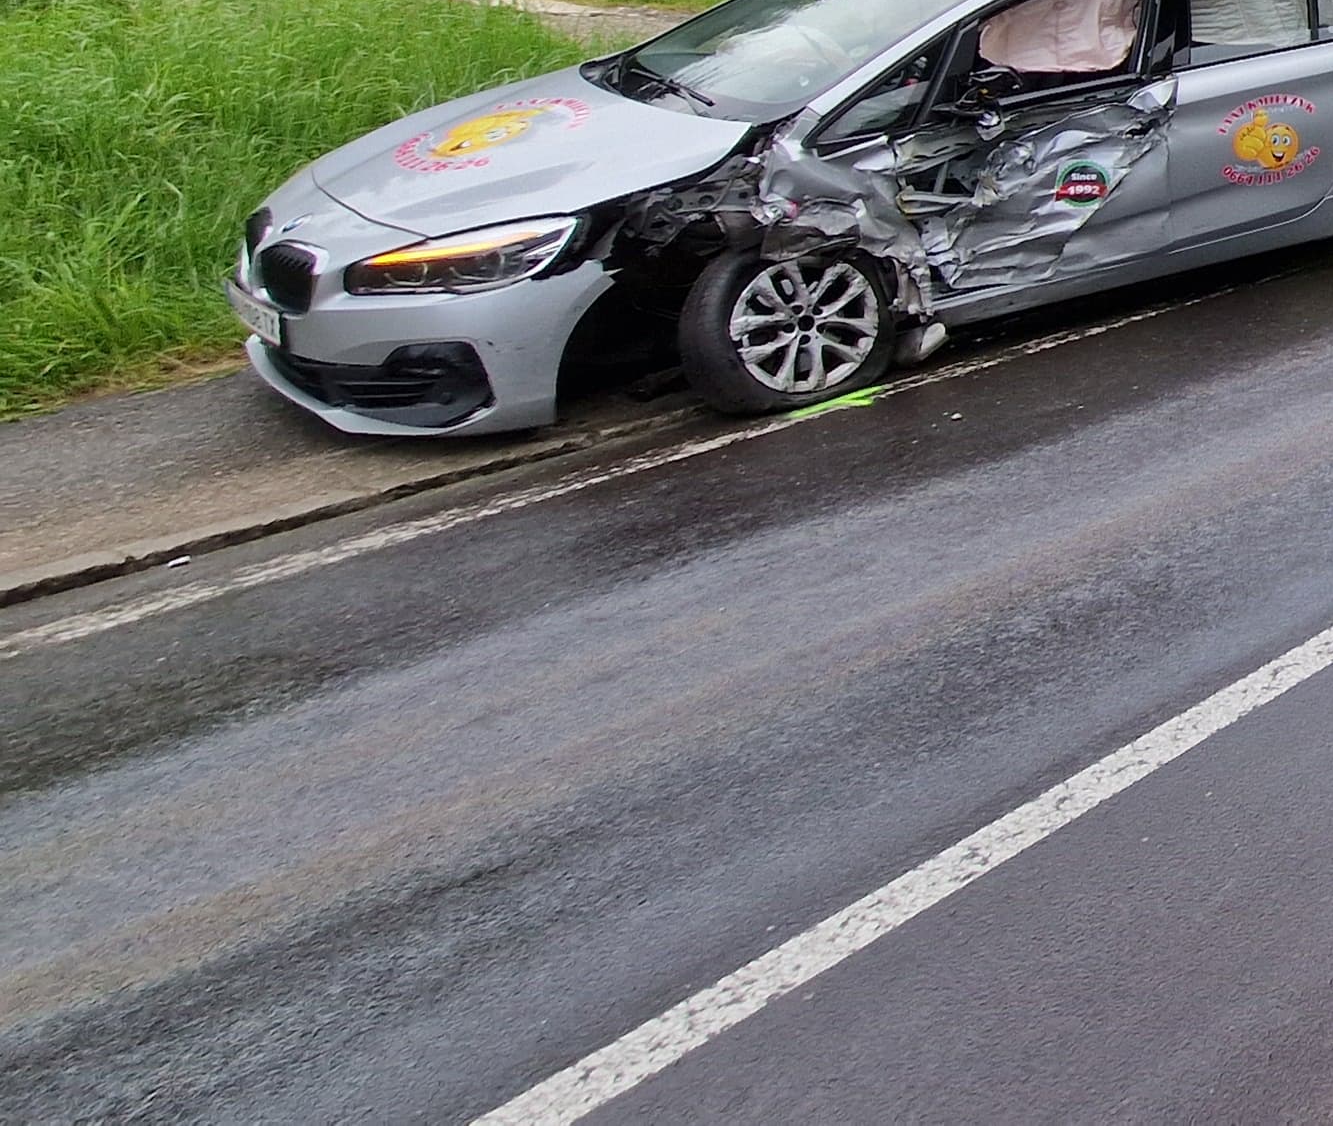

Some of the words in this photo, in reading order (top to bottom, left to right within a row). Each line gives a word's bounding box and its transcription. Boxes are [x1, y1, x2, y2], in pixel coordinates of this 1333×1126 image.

[1222, 164, 1255, 185] 0664
[1257, 172, 1283, 185] 111
[1286, 162, 1304, 177] 26
[1305, 146, 1321, 164] 26
[1070, 173, 1098, 181] Since
[1067, 184, 1100, 195] 1992
